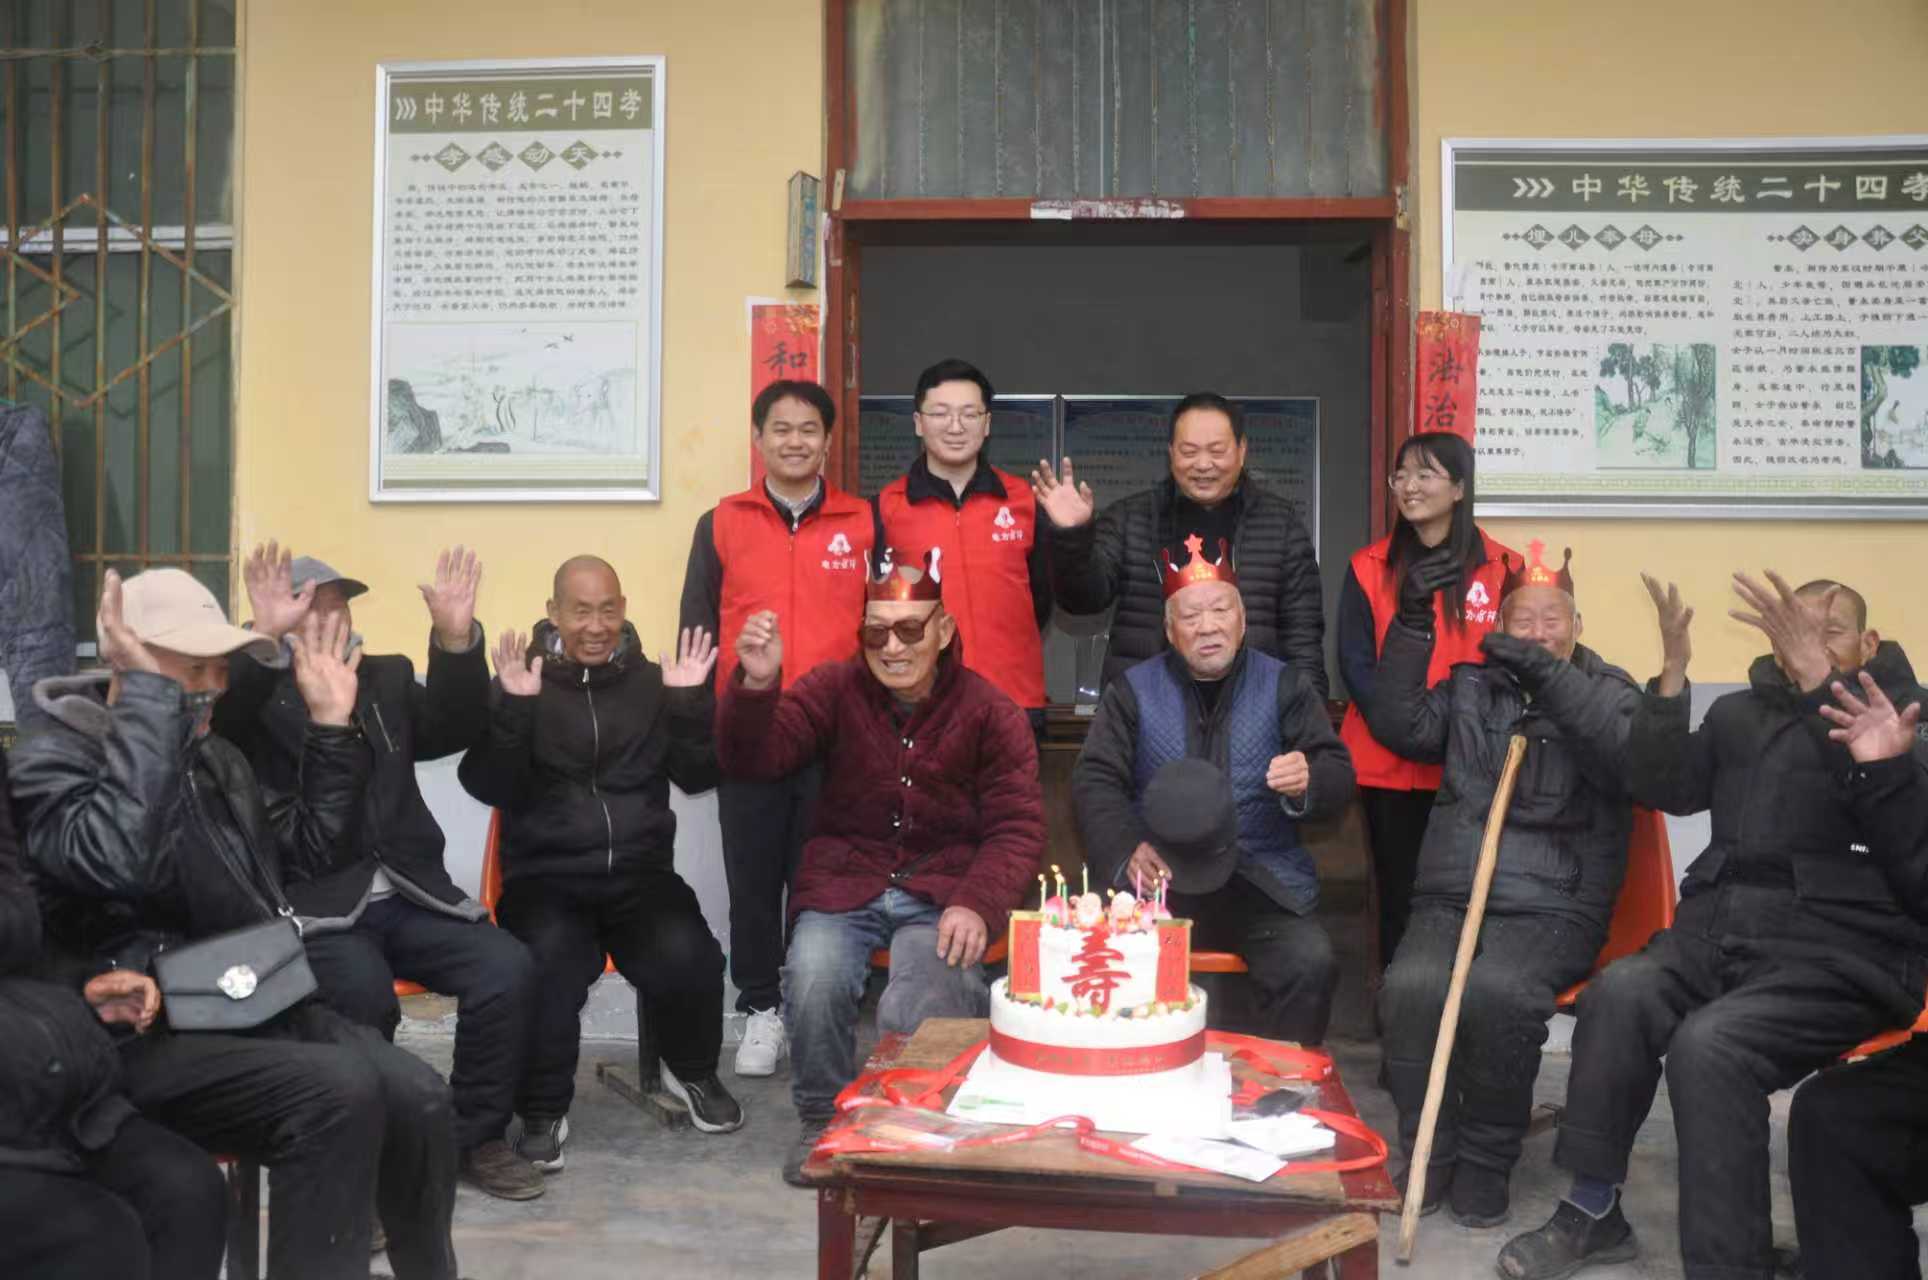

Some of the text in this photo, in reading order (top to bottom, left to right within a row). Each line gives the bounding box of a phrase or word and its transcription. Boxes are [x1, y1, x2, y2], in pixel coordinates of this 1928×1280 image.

[425, 88, 643, 125] 中华传统二十四孝
[1570, 172, 1928, 205] 中华传统二十四孝
[1060, 922, 1132, 1014] 寿
